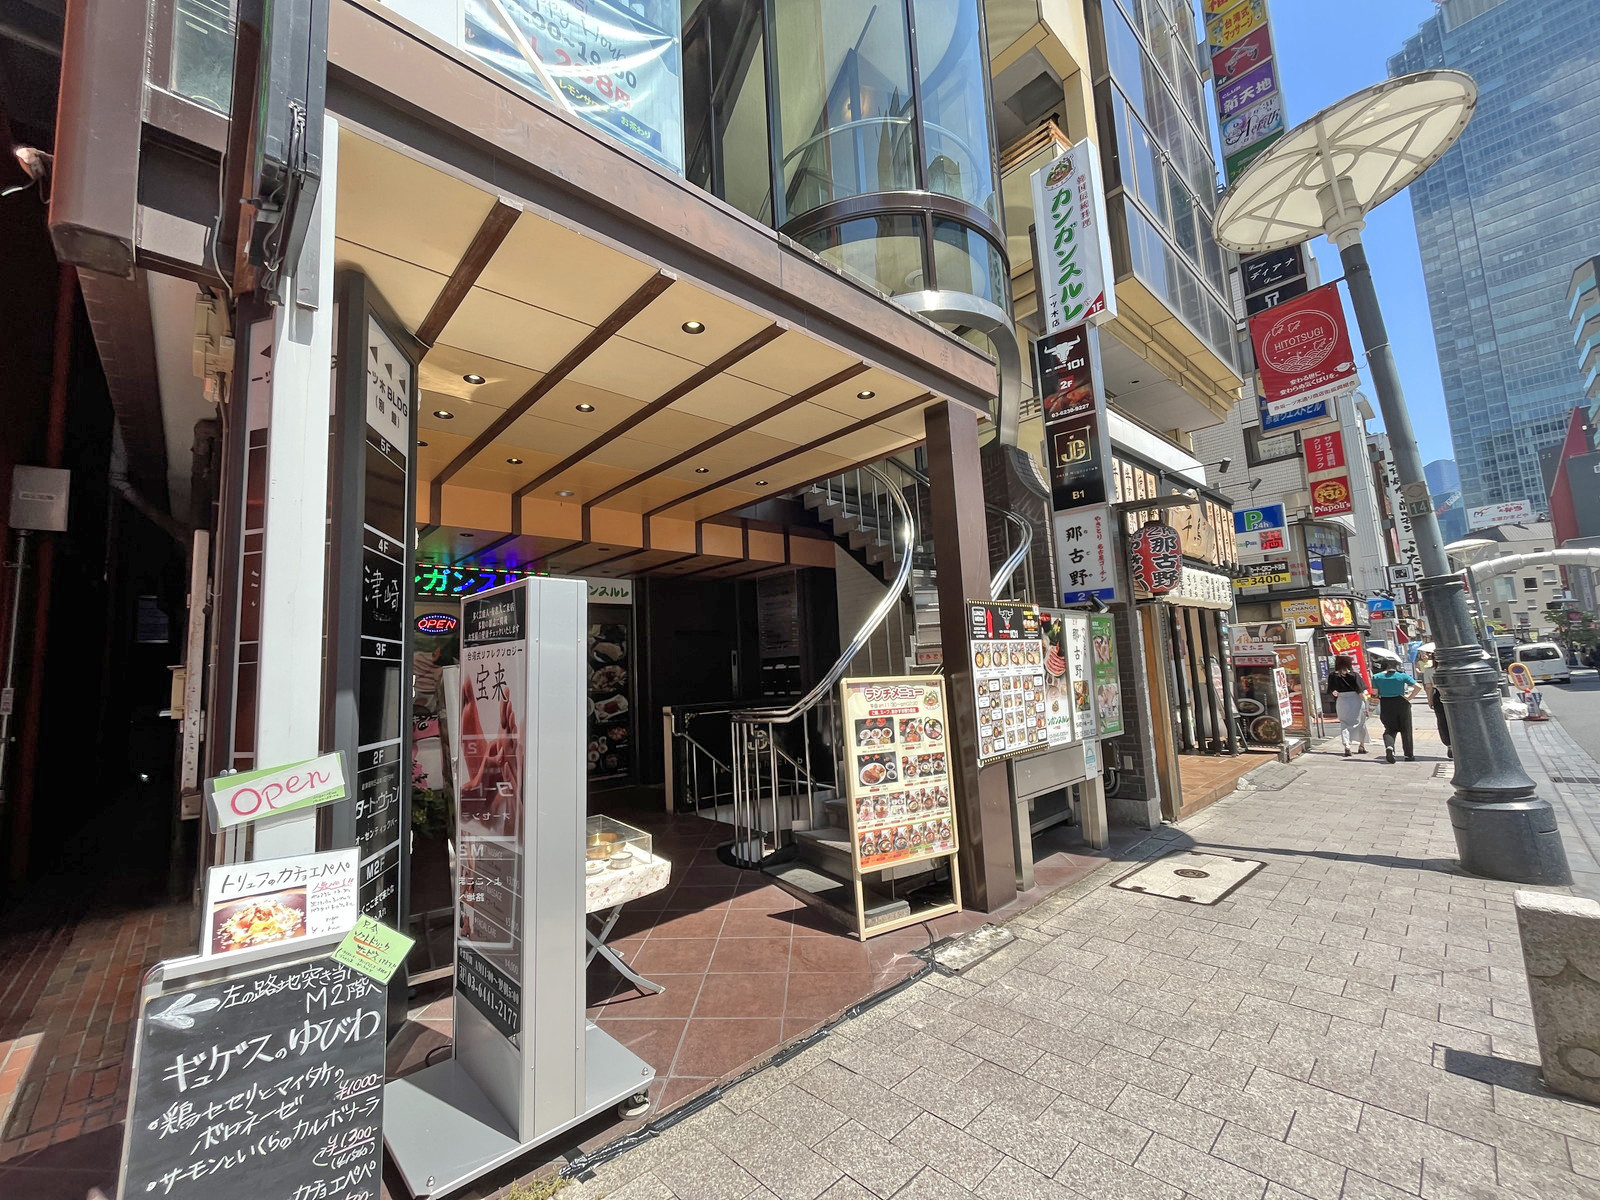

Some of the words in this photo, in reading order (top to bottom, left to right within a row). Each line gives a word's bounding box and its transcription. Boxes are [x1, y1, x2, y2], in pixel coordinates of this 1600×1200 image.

[1223, 78, 1272, 113] 新天地
[620, 114, 651, 139] お茶わり
[1052, 187, 1083, 322] カンガンスルレ
[1250, 257, 1295, 281] ディアナ
[1049, 294, 1060, 328] 一ツ木店
[1091, 301, 1103, 313] 1F
[1274, 326, 1324, 351] HITOTSUGI
[1067, 358, 1084, 371] 101
[1060, 380, 1073, 390] 2F
[387, 386, 409, 417] BLDG
[380, 438, 391, 455] 5F
[1314, 438, 1324, 469] クリニック
[1072, 489, 1085, 500] B1
[1315, 501, 1351, 513] Napoli's
[1244, 511, 1263, 531] P
[1410, 502, 1427, 514] 14
[1094, 515, 1103, 541] やきとり
[1254, 522, 1269, 530] 24h
[378, 539, 389, 552] 4F
[1065, 525, 1088, 586] 那古野
[1097, 543, 1107, 582] 名古屋コーチン
[1150, 536, 1178, 588] 那古野
[364, 565, 399, 612] 津崎
[1283, 605, 1318, 613] EXCHANGE
[418, 619, 456, 630] OPEN
[375, 643, 387, 656] 3F
[476, 663, 509, 702] 宝来
[865, 687, 924, 702] ランチメニュー
[372, 750, 384, 765] 2F
[230, 770, 330, 816] Open
[221, 861, 351, 894] トリュフのカチョエペペ
[365, 854, 386, 880] M2F
[306, 978, 382, 1014] M2階へ
[467, 972, 518, 1030] 03-6441-2177
[162, 1007, 381, 1093] ギュゲスのゆびわ
[157, 1061, 345, 1140] 鶏セセリとマイタケの
[190, 1096, 304, 1155] ボロネーゼ
[162, 1098, 381, 1194] サーモンといくらのカルボナーラ
